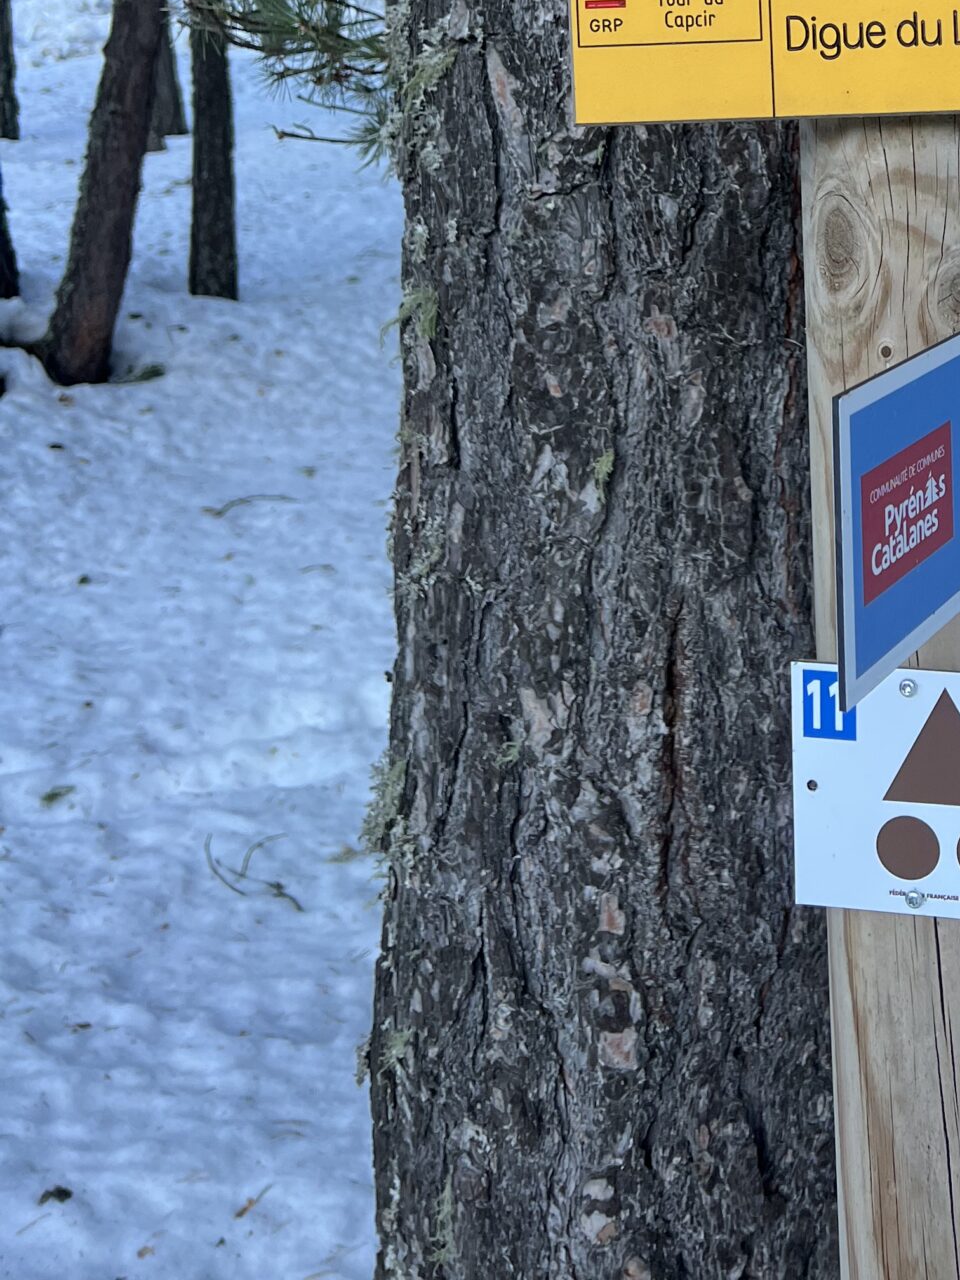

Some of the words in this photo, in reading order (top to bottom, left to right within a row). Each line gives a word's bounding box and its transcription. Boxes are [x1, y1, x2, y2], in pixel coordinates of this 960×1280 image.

[589, 18, 624, 33] GRP
[664, 10, 716, 32] Capcir
[785, 15, 888, 61] Digue
[896, 11, 943, 48] du
[869, 466, 909, 505] COMMUNAUTÉ
[908, 463, 917, 478] DE
[916, 444, 946, 473] COMMUNES
[806, 679, 843, 731] 11
[926, 893, 959, 902] FRANÇAISE
